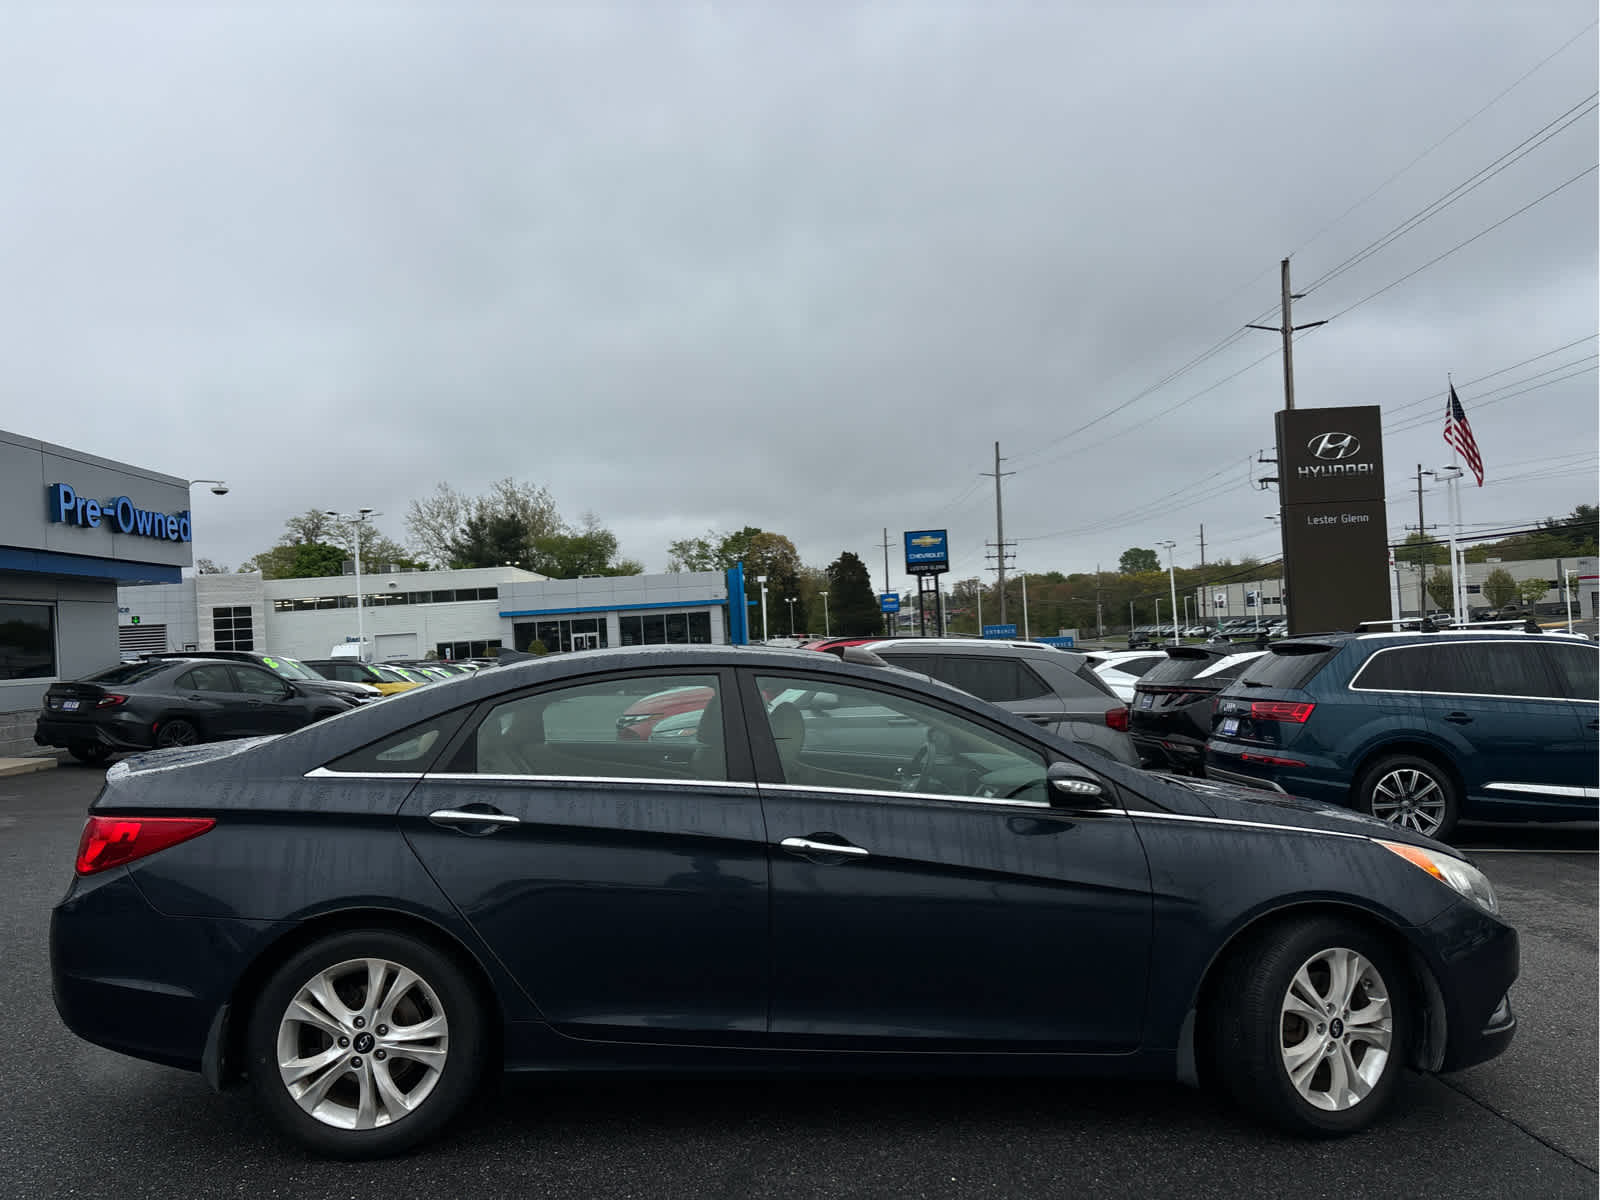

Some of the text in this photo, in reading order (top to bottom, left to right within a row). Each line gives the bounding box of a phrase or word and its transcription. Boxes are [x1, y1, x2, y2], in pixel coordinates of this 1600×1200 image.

[1297, 463, 1374, 478] HYUNDAI
[52, 482, 192, 542] Pre-Owned
[1307, 513, 1369, 525] Lester Glenn
